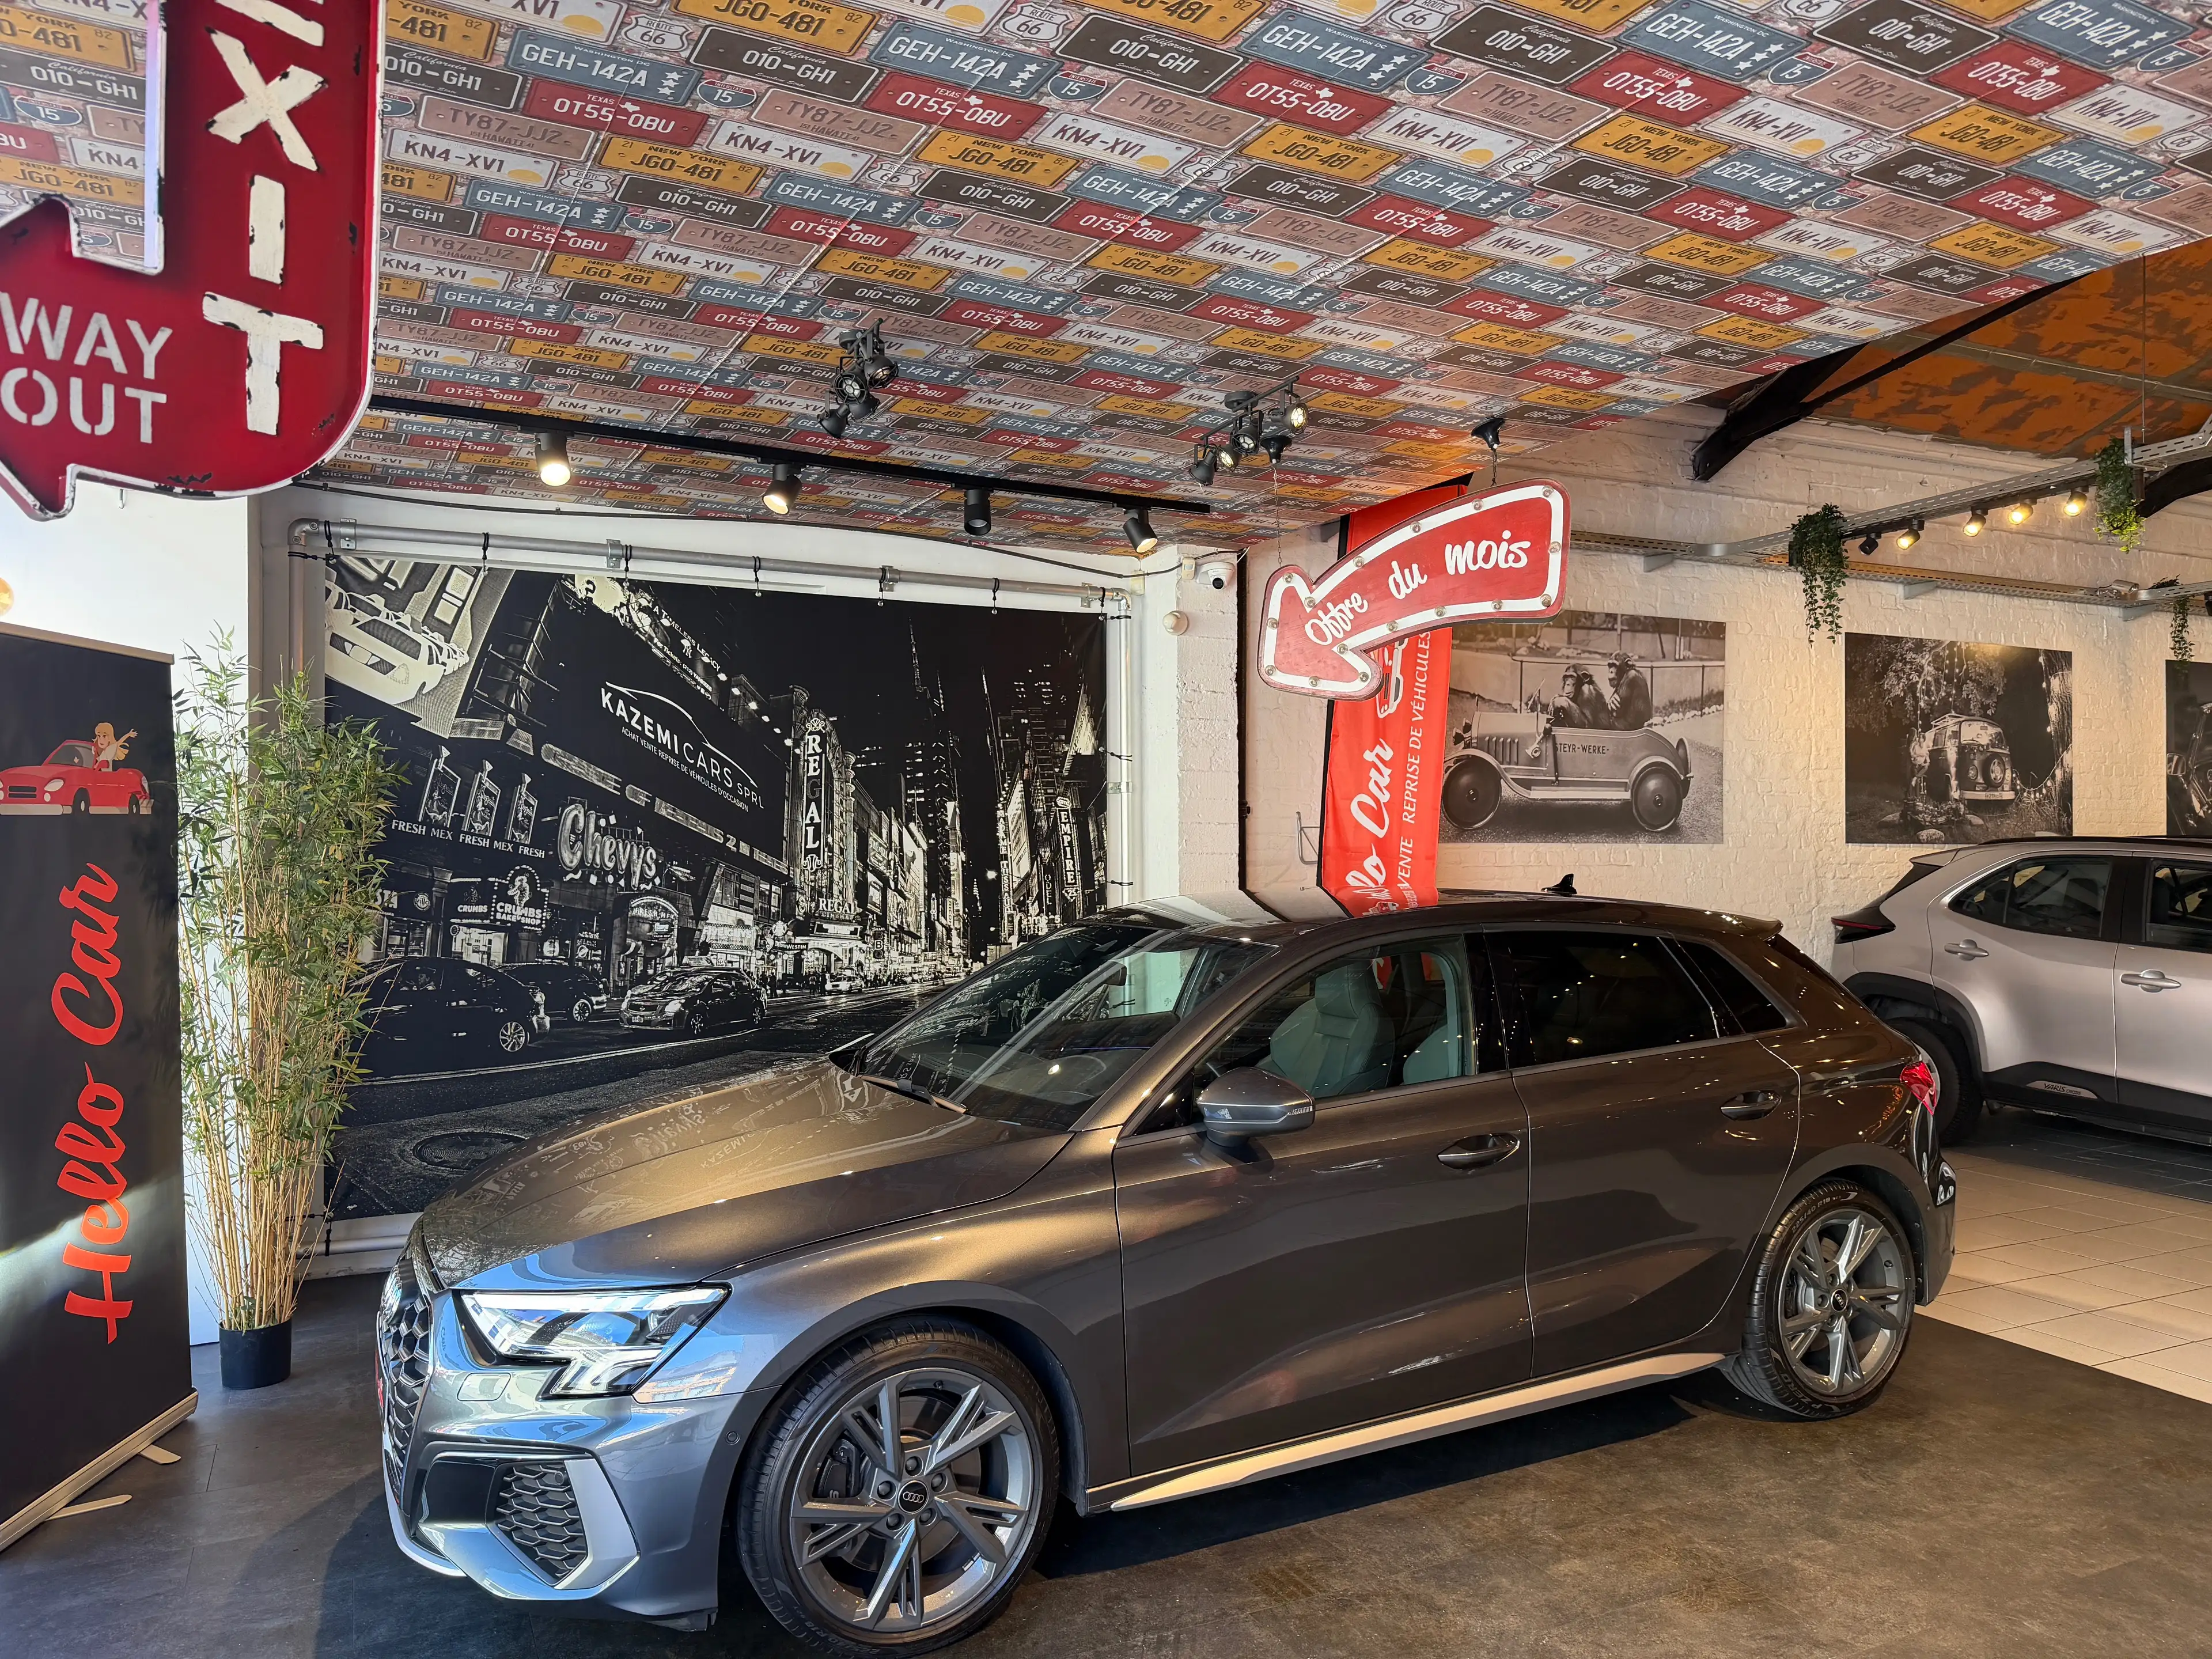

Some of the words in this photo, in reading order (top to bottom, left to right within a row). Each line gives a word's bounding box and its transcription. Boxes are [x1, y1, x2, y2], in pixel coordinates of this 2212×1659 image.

[1030, 9, 1055, 21] ROUTE
[1421, 0, 1448, 12] ROUTE
[646, 20, 675, 31] ROUTE
[843, 13, 865, 24] 82
[1404, 9, 1428, 25] 66
[1715, 14, 1758, 33] WASHINGTON
[1906, 14, 1958, 33] California
[1017, 21, 1041, 36] 66
[1325, 27, 1374, 45] WASHINGTON
[1518, 25, 1573, 43] California
[1647, 13, 1758, 59] GEH-142A
[643, 30, 666, 46] 66
[946, 37, 999, 54] WASHINGTON
[575, 46, 634, 63] WASHINGTON
[766, 47, 827, 64] California
[1263, 25, 1379, 71] GEH-142A
[521, 44, 649, 88] GEH-142A
[1776, 65, 1813, 78] 15
[2021, 56, 2051, 69] TEXAS
[933, 87, 963, 98] TEXAS
[1058, 82, 1087, 95] 15
[1287, 78, 1317, 90] TEXAS
[586, 94, 616, 104] TEXAS
[711, 90, 736, 103] 15
[1638, 126, 1672, 136] NEW
[1669, 134, 1705, 146] YORK
[648, 146, 683, 156] NEW
[688, 154, 729, 165] YORK
[971, 140, 1005, 150] NEW
[1008, 147, 1047, 158] YORK
[1714, 161, 1805, 193] GEH-142A
[981, 182, 1031, 194] California
[1082, 176, 1182, 207] GEH-142A
[475, 189, 582, 219] GEH-142A
[1410, 207, 1434, 215] TEXAS
[1217, 210, 1242, 219] 15
[1725, 247, 1755, 255] YORK
[1489, 271, 1569, 294] GEH-142A
[958, 282, 1044, 304] GEH-142A
[0, 292, 172, 380] WAY
[1323, 352, 1395, 369] GEH-142A
[1, 368, 166, 444] OUT
[1388, 560, 1427, 600] du
[1445, 530, 1531, 575] mois
[1410, 631, 1431, 721] VÉHICULES
[1408, 726, 1423, 749] DE
[601, 688, 678, 754] KAZEMI
[683, 743, 733, 787] CARS
[737, 782, 764, 809] SPRL
[622, 727, 639, 742] ACHAT
[641, 737, 657, 755] VENTE
[659, 749, 680, 769] REPRISE
[681, 764, 688, 774] DE
[689, 768, 717, 793] VÉHICULES
[718, 789, 748, 812] D'OCCASION
[804, 734, 823, 849] REGAL
[1350, 738, 1393, 838] Car
[1402, 752, 1420, 824] REPRISE
[391, 820, 426, 835] FRESH
[431, 828, 453, 840] MEX
[459, 834, 490, 848] FRESH
[494, 840, 513, 852] MEX
[518, 846, 546, 858] FRESH
[557, 804, 656, 891] Chevys
[1060, 811, 1075, 884] EMPIRE
[496, 902, 542, 919] CRUMBS
[818, 897, 857, 914] REGAL
[496, 912, 517, 922] BAKE
[521, 916, 541, 926] SHOP
[52, 863, 123, 1046] Car
[2044, 1084, 2066, 1092] YARIS
[56, 1063, 132, 1343] Hello
[1817, 1197, 1831, 1208] R18
